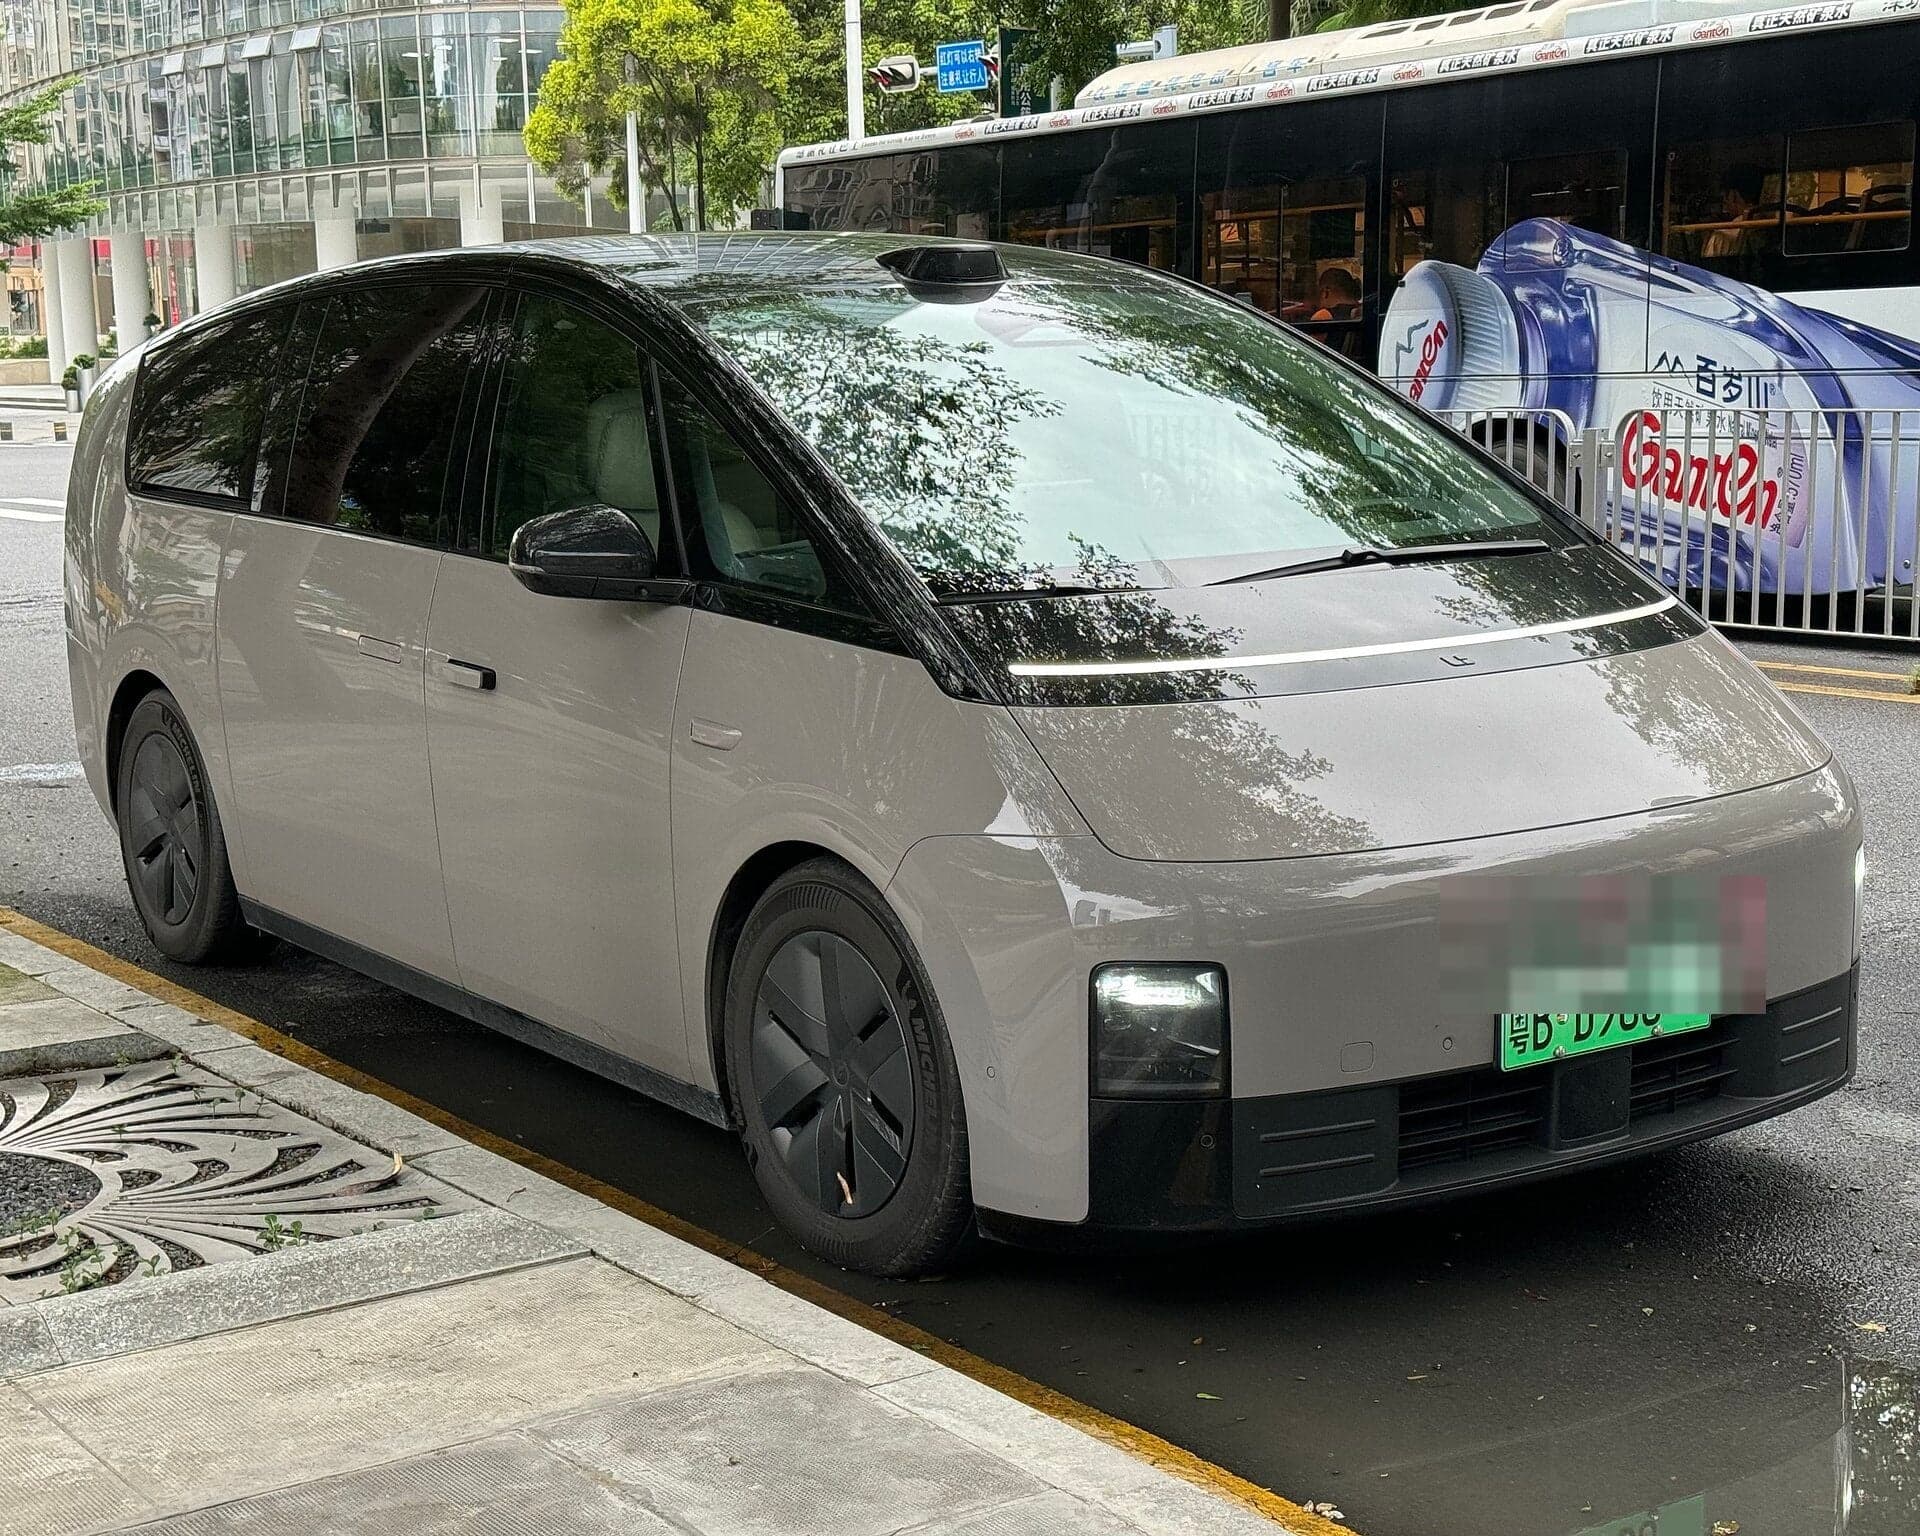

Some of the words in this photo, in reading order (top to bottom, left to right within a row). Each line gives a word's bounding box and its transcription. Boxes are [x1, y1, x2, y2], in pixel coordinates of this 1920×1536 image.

[941, 68, 985, 87] 注意礼让行人
[1189, 87, 1255, 109] 真正天然矿泉水
[1308, 69, 1381, 92] 真正天然矿泉水
[1438, 49, 1520, 74] 真正天然矿泉水
[1585, 27, 1676, 54] 真正天然矿泉水
[1749, 4, 1851, 32] 真正天然矿泉水
[1409, 320, 1449, 402] anten
